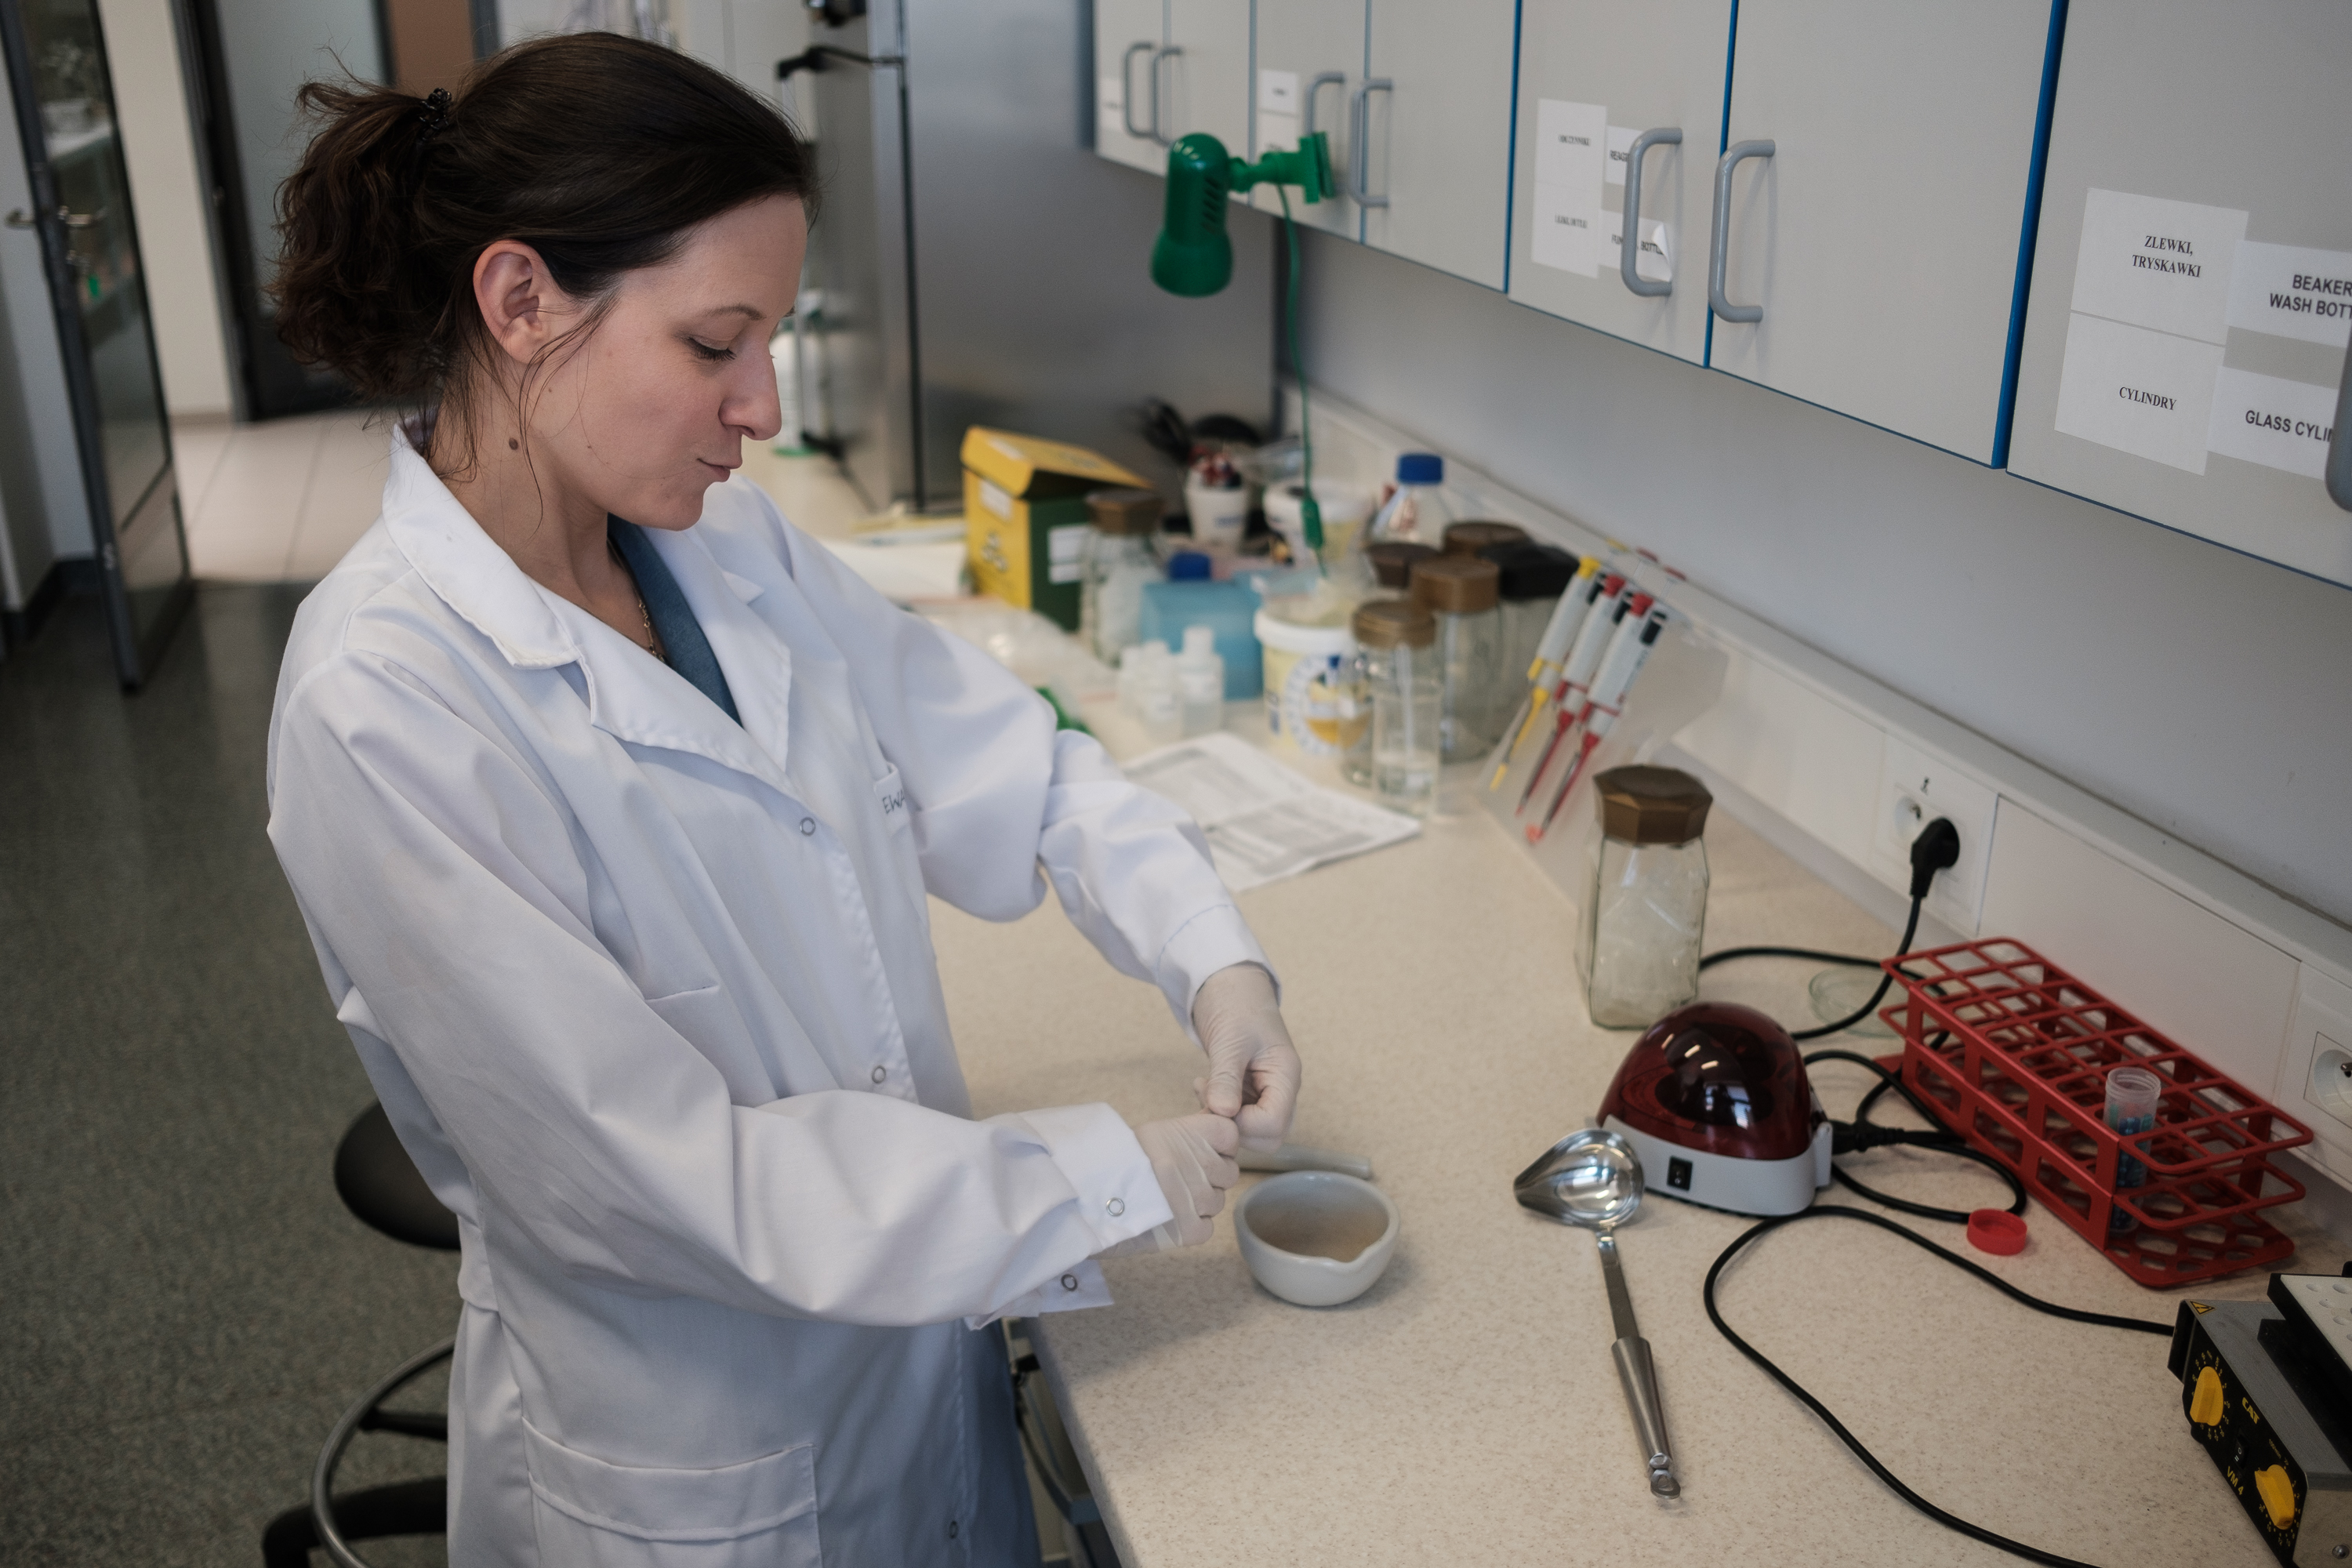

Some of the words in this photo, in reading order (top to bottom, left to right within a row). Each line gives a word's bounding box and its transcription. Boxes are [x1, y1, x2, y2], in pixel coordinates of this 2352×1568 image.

[1641, 241, 1664, 255] BOTTL
[2144, 235, 2193, 256] ZLEWKI,
[2132, 255, 2201, 278] TRYSKAWKI
[2292, 274, 2352, 297] BEAKER
[2270, 292, 2312, 314] WASH
[2119, 387, 2177, 411] CYLINDRY
[2245, 409, 2291, 433] GLASS
[2242, 1397, 2259, 1424] CAT
[2227, 1466, 2238, 1487] VM
[2238, 1486, 2244, 1495] 4
